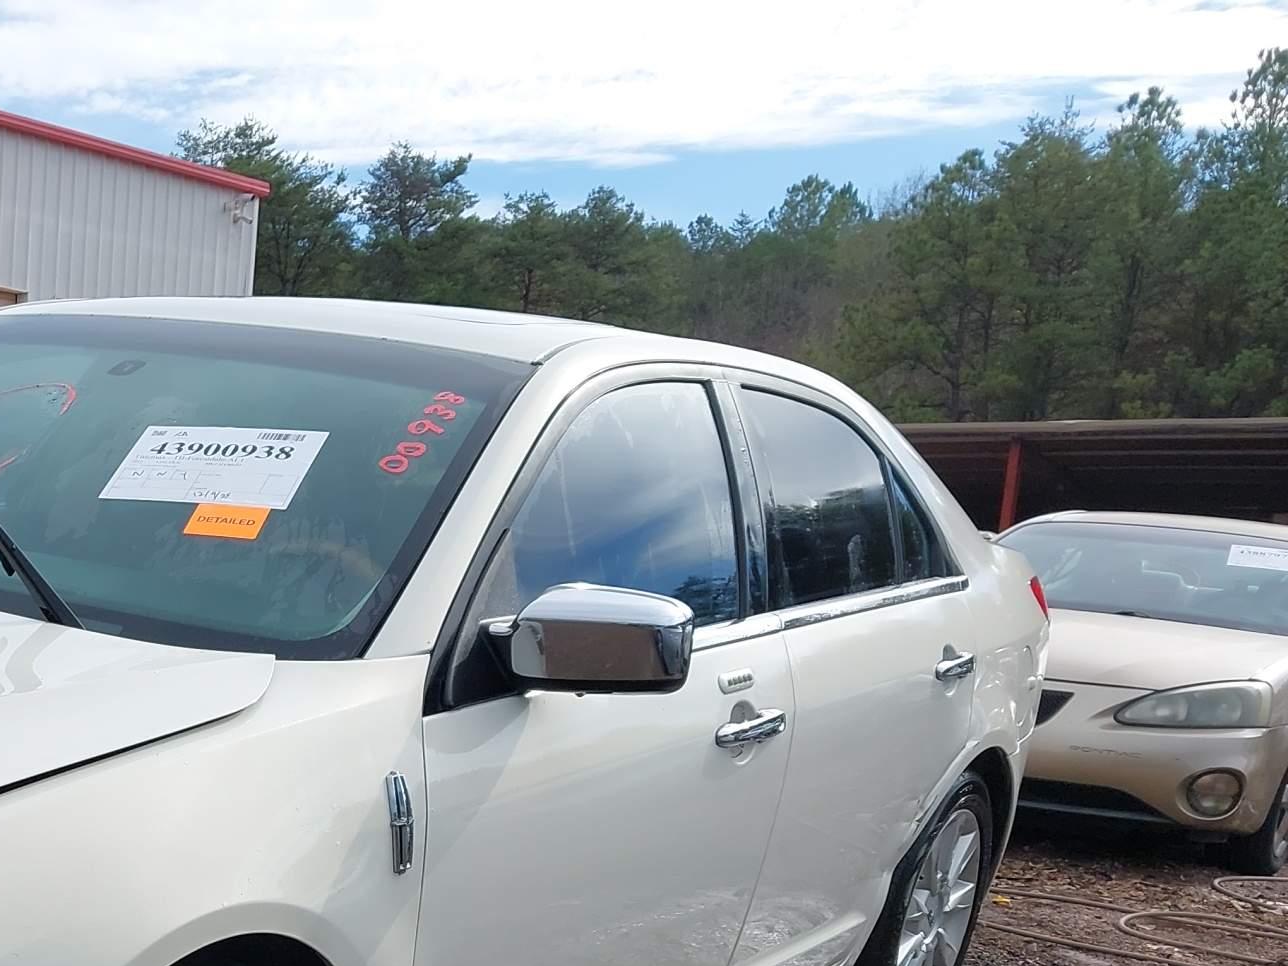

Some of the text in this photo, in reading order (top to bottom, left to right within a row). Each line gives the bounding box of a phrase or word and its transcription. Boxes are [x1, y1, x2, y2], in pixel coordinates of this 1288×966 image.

[149, 441, 296, 461] 43900938
[196, 515, 257, 527] DETAILED
[1069, 745, 1143, 760] PONTIAC
